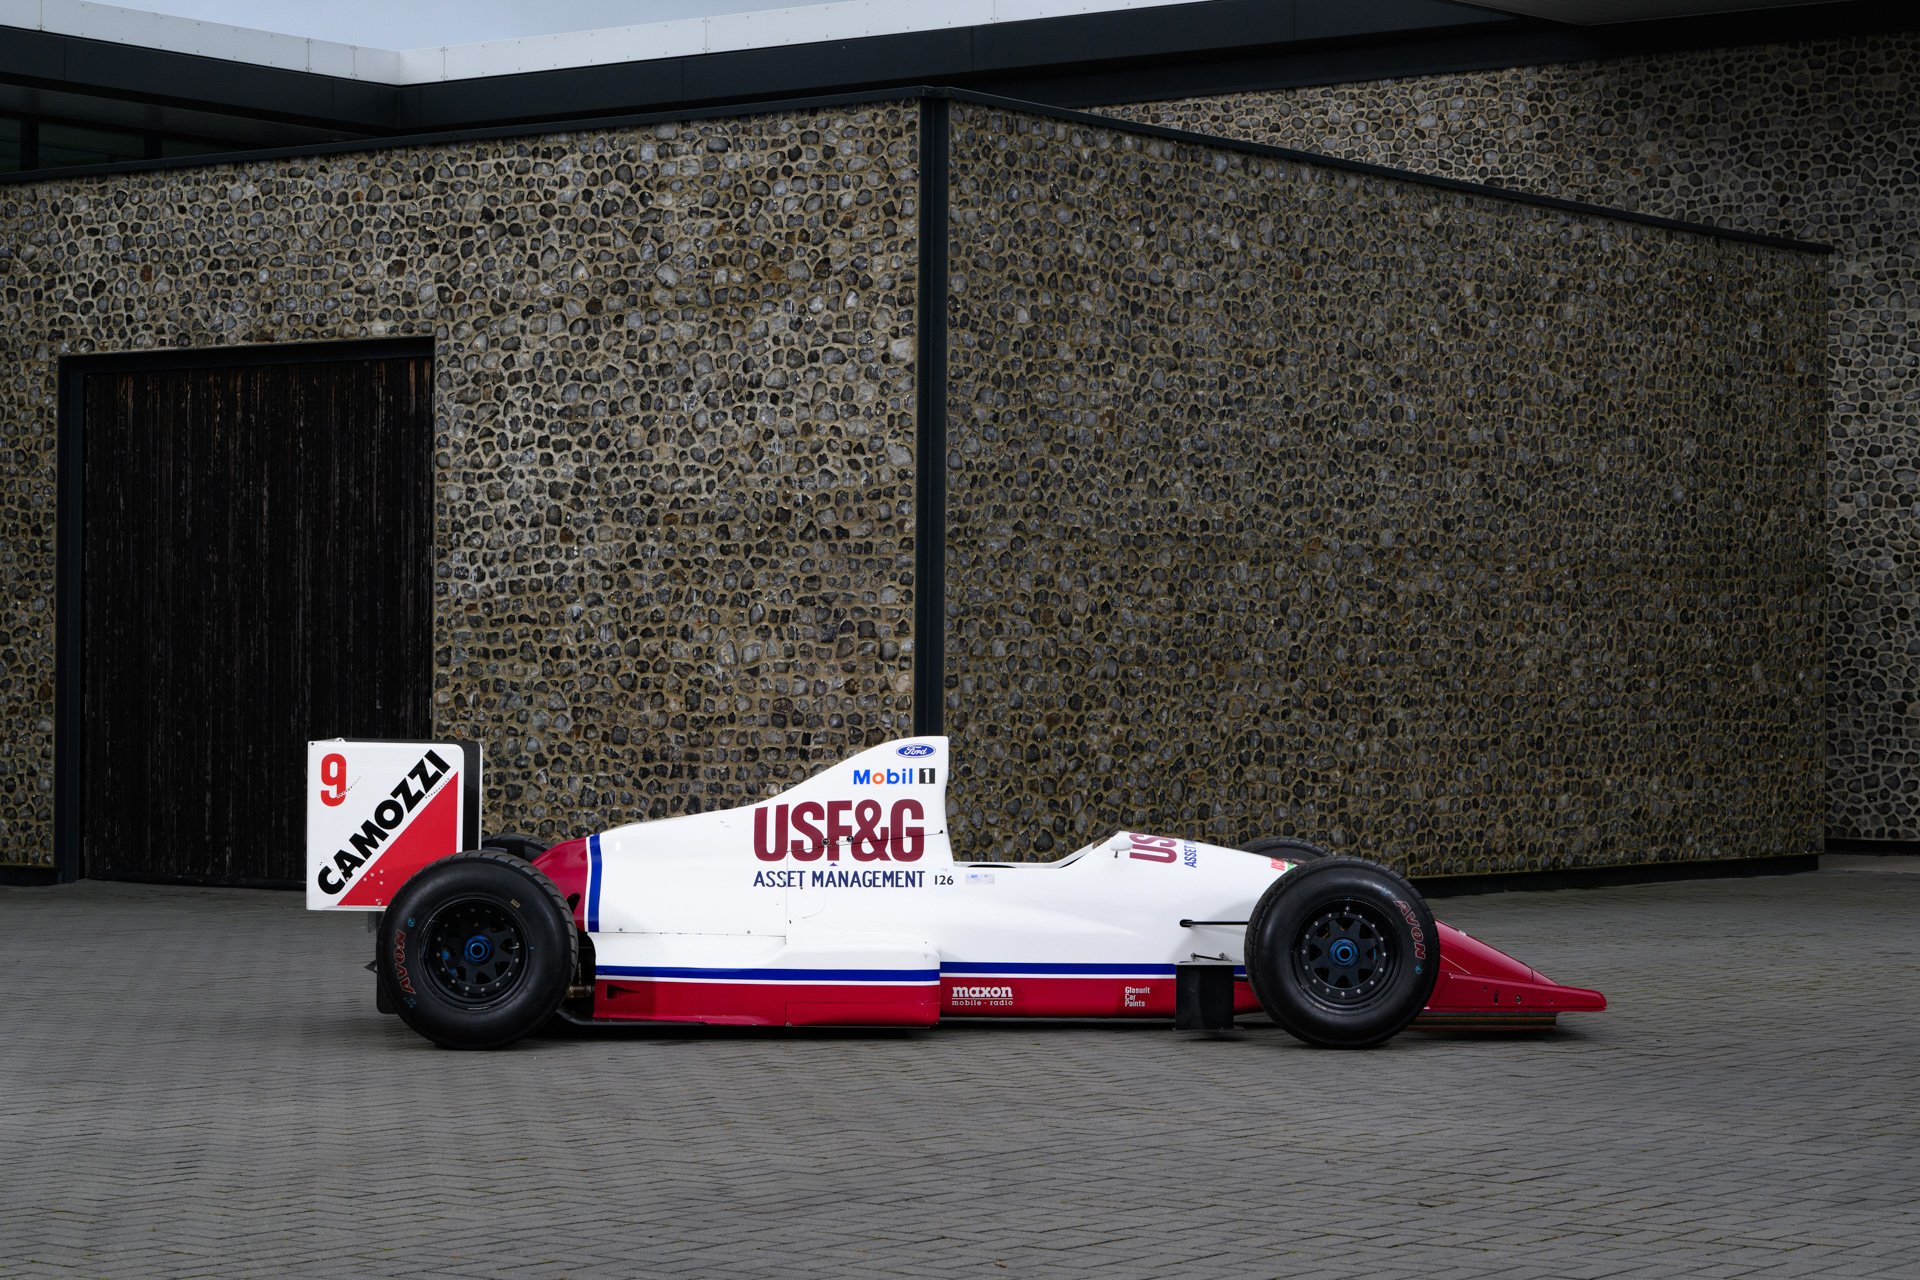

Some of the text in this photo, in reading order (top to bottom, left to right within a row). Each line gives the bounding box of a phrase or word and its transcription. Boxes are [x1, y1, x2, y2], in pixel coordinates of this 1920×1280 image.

[320, 753, 347, 807] 9
[853, 768, 913, 785] Mobil
[317, 749, 451, 895] CAMOZZI
[753, 798, 925, 862] USF&G
[753, 870, 925, 888] ASSET MANAGEMENT
[934, 875, 954, 886] 126
[1393, 900, 1426, 960] AVON
[394, 929, 416, 994] AVON
[952, 986, 1013, 998] maxon
[1124, 986, 1150, 994] Glasurit
[1124, 993, 1136, 1001] Car
